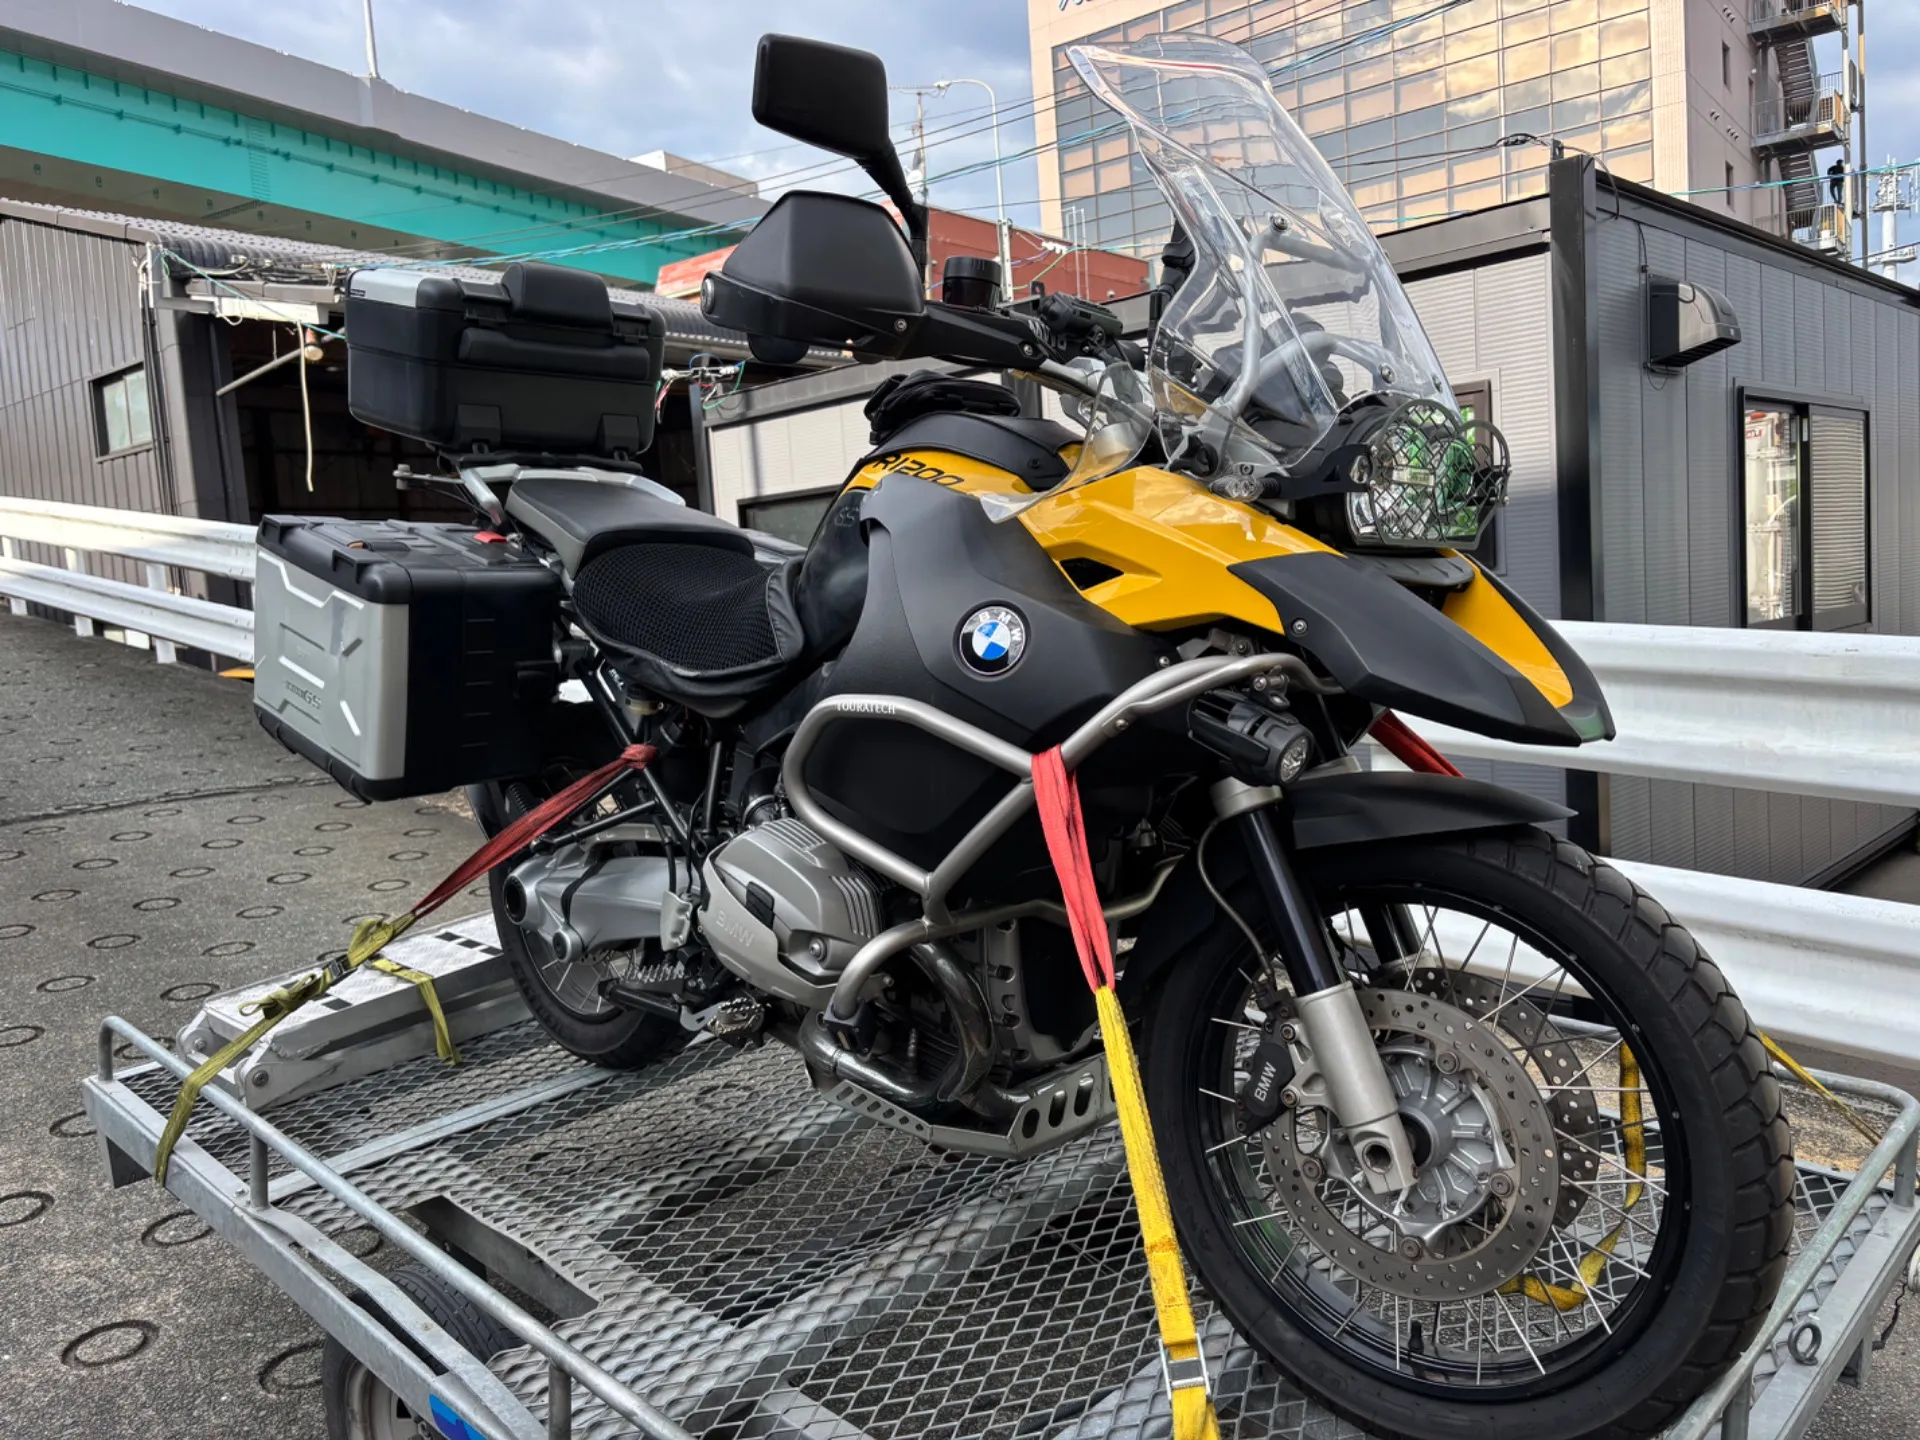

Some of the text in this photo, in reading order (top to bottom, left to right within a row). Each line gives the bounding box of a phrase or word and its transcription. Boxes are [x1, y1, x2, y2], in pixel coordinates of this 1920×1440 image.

[873, 453, 965, 486] R1200
[978, 610, 1023, 641] BMW
[834, 699, 896, 715] TOURATECH
[715, 908, 755, 948] BMW
[1254, 1061, 1277, 1102] BMW
